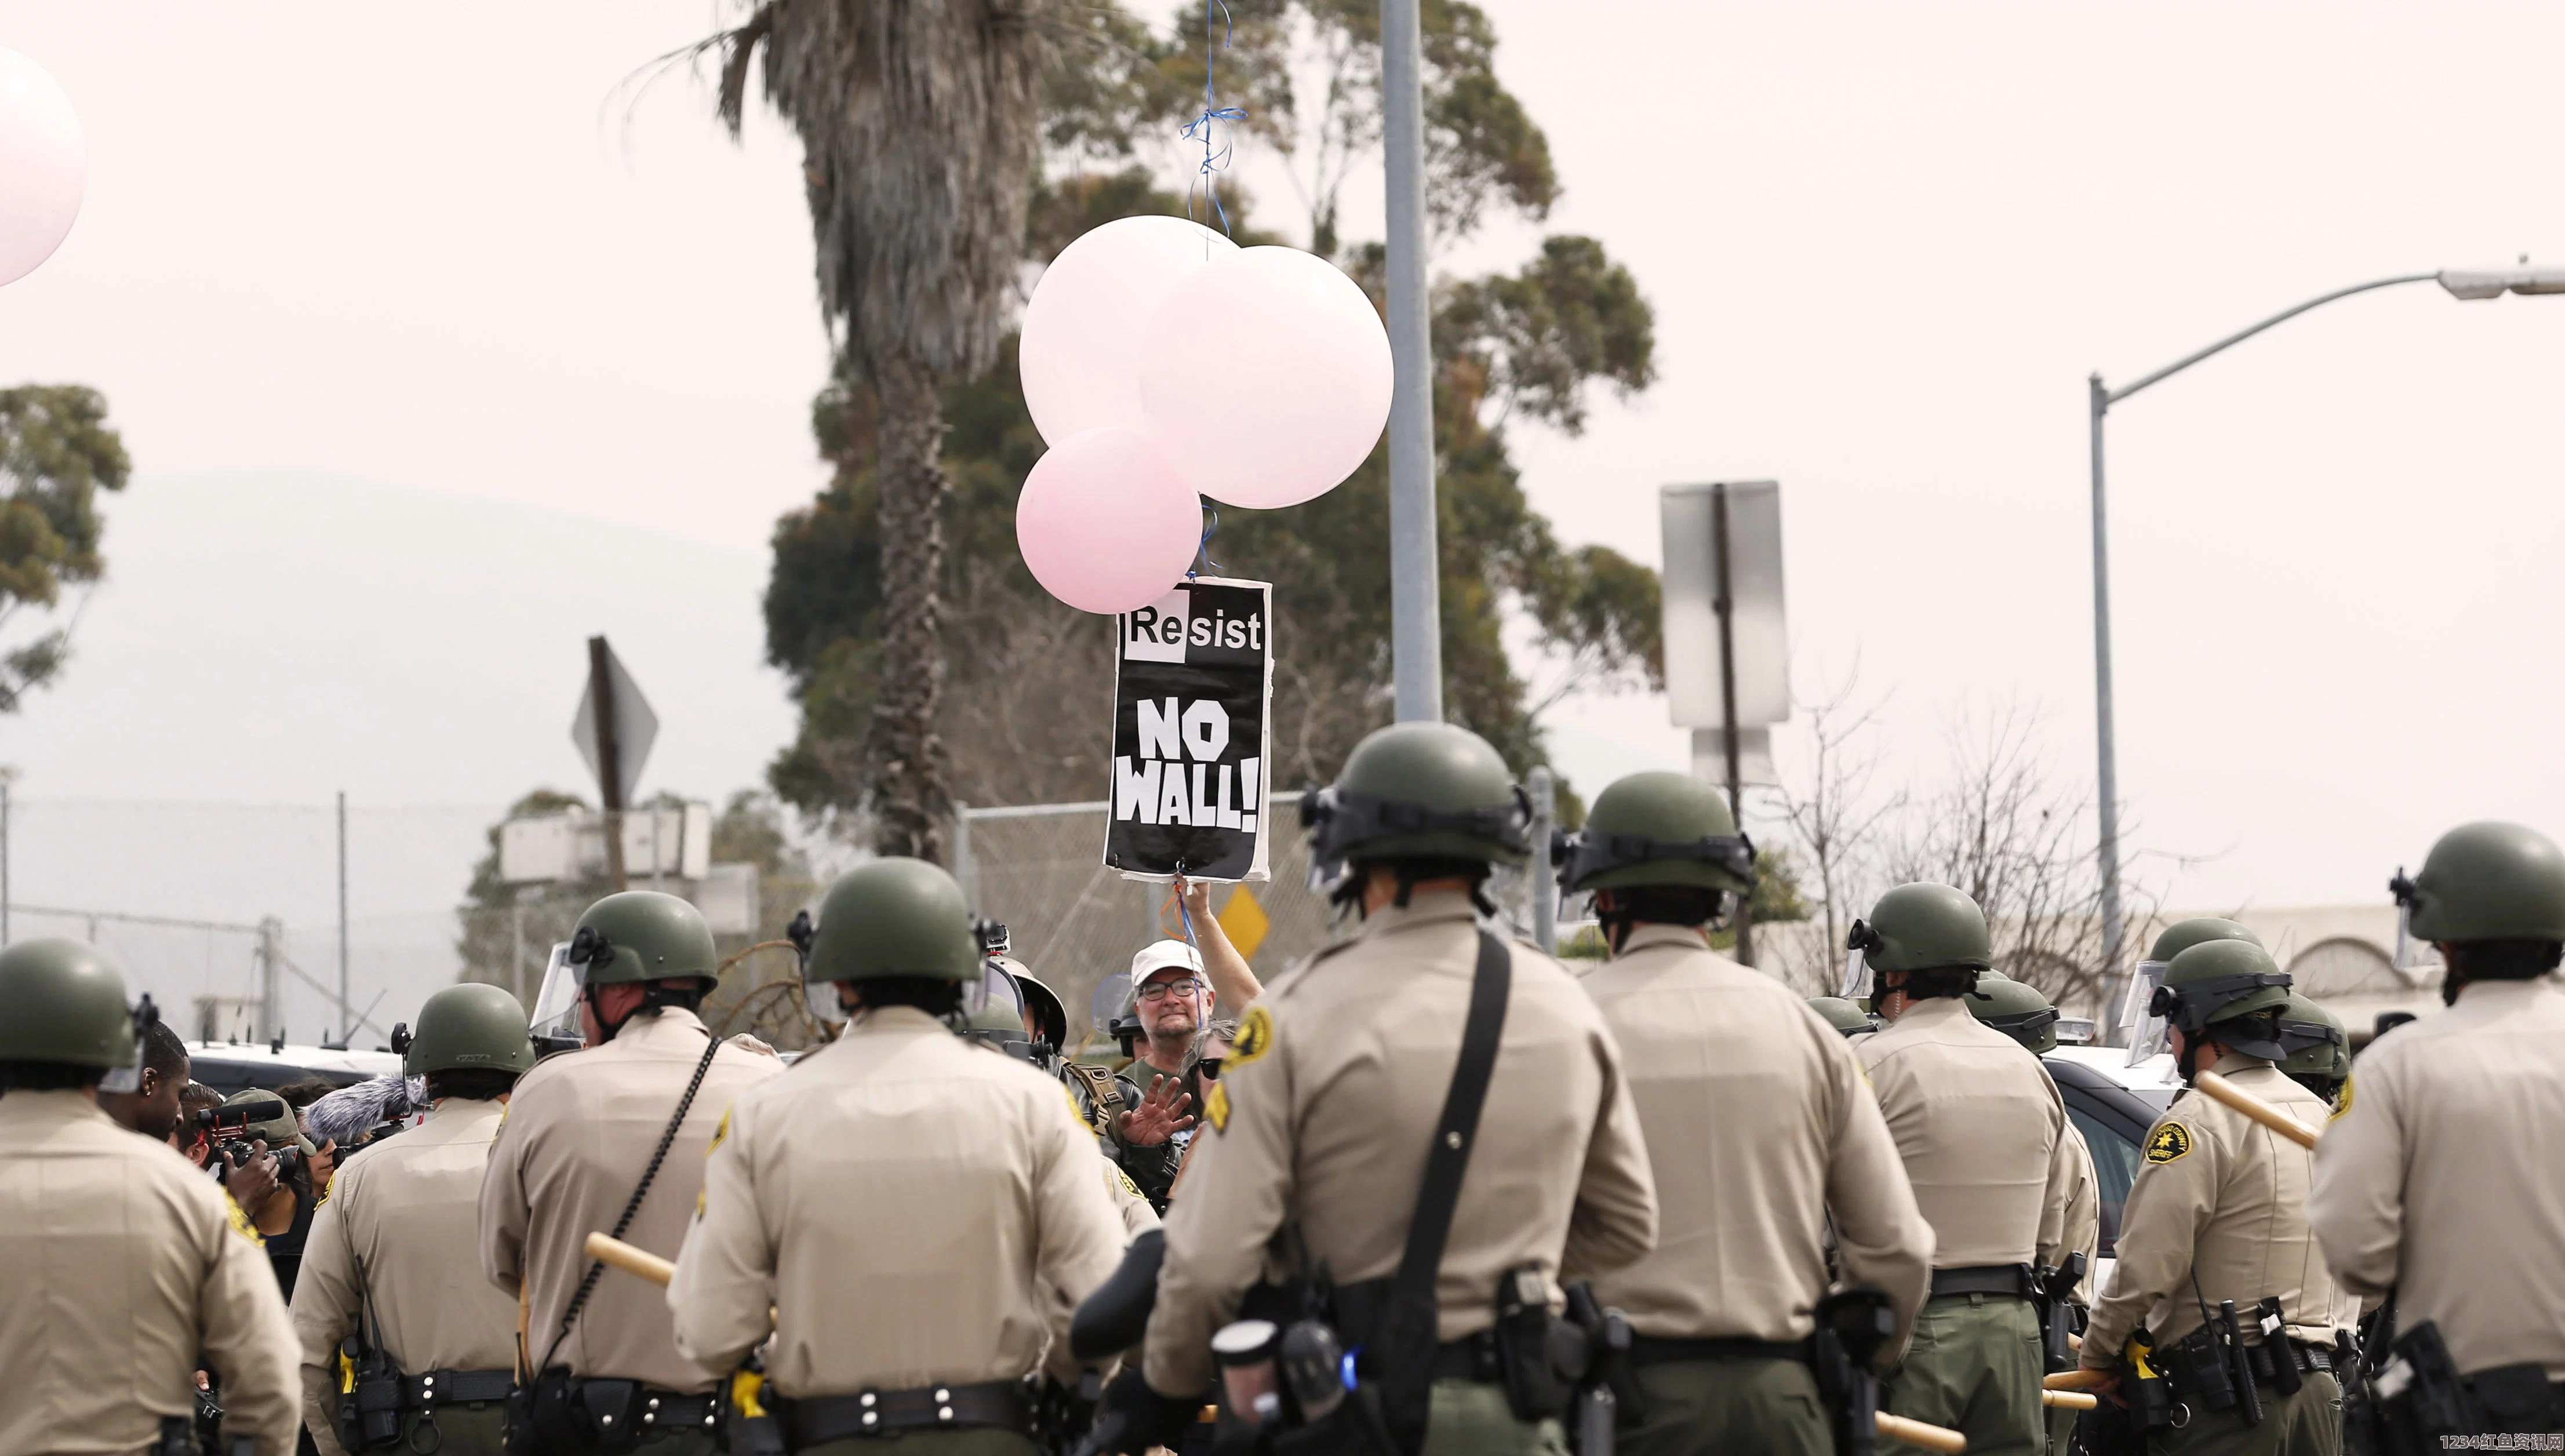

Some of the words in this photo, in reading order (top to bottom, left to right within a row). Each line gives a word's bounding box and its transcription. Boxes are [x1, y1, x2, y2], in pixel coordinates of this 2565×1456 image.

[1130, 605, 1261, 650] Resist
[1137, 697, 1229, 762] NO
[1115, 755, 1260, 833] WALL!
[2148, 1149, 2174, 1159] SHERIFF
